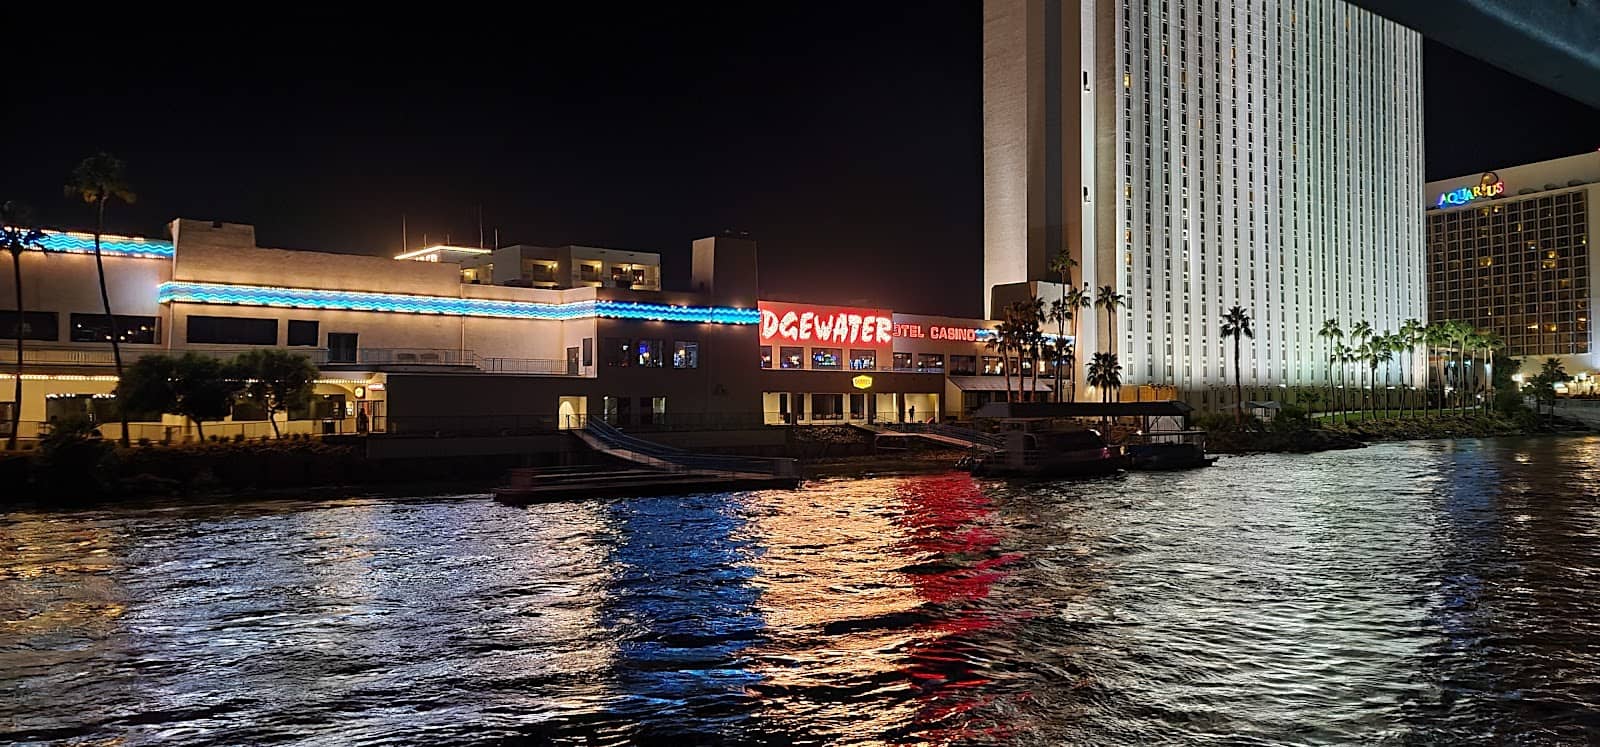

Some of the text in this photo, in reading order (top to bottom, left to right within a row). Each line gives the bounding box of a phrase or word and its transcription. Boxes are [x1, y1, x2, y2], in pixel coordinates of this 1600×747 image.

[1438, 182, 1504, 206] AQUARIUS
[761, 309, 892, 344] DGEWATER
[930, 326, 976, 341] CASINO
